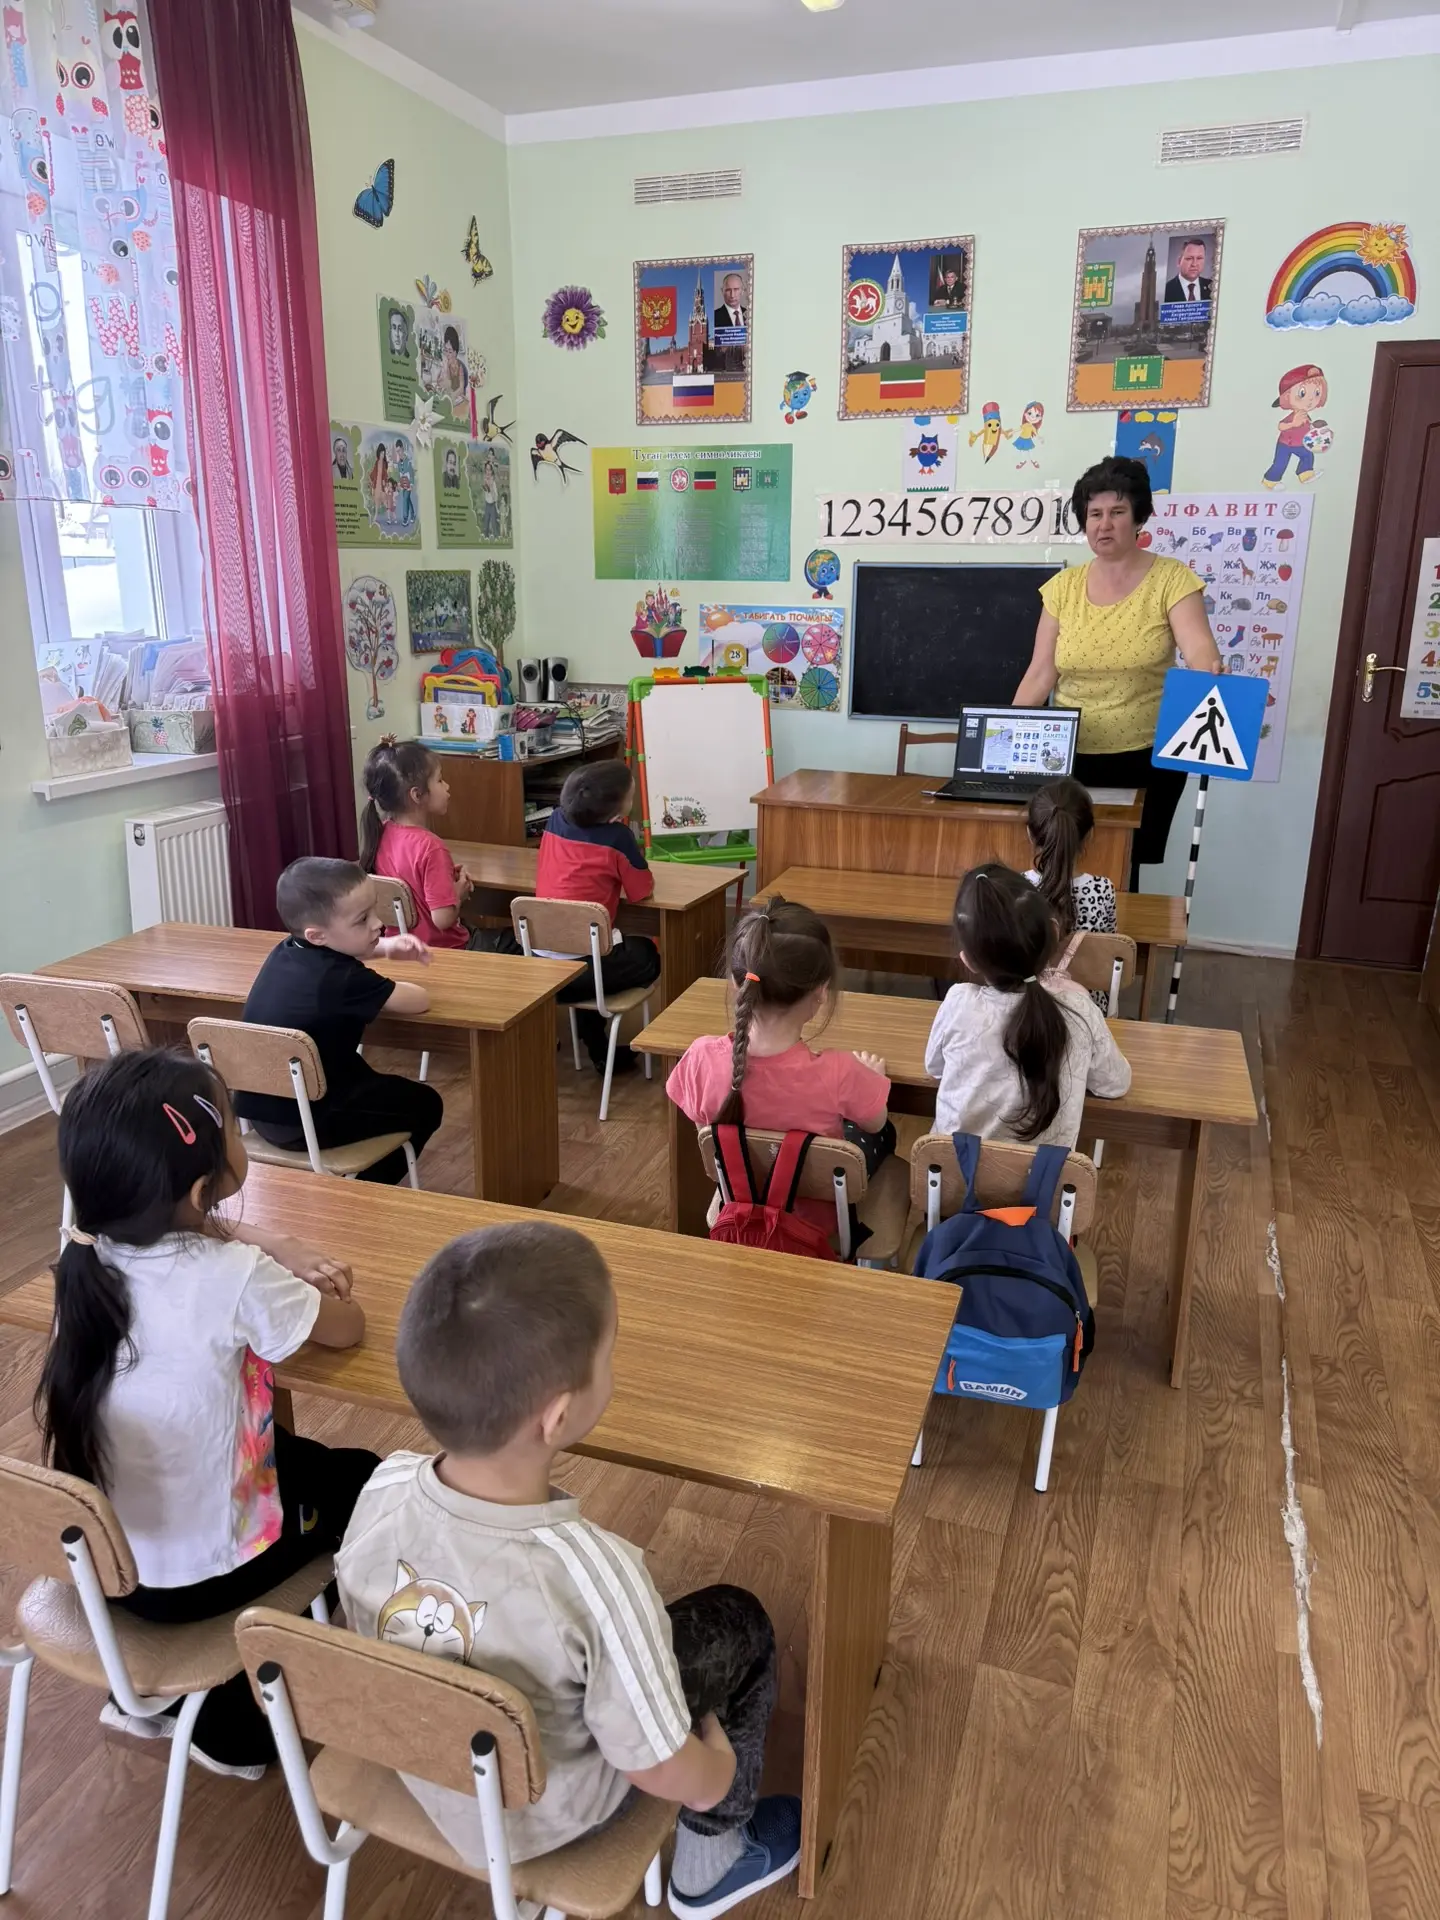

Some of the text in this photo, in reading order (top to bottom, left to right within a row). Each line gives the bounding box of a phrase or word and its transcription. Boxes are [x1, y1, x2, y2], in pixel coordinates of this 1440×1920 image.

[633, 449, 662, 462] Туган
[1192, 526, 1207, 536] Бб
[1219, 591, 1233, 600] Кк
[743, 611, 786, 621] ТАБИГАТЬ
[1424, 620, 1440, 638] 3
[730, 649, 741, 660] 28
[1420, 649, 1436, 668] 4
[1416, 681, 1431, 699] 5
[962, 1382, 1023, 1398] ВАМИН
